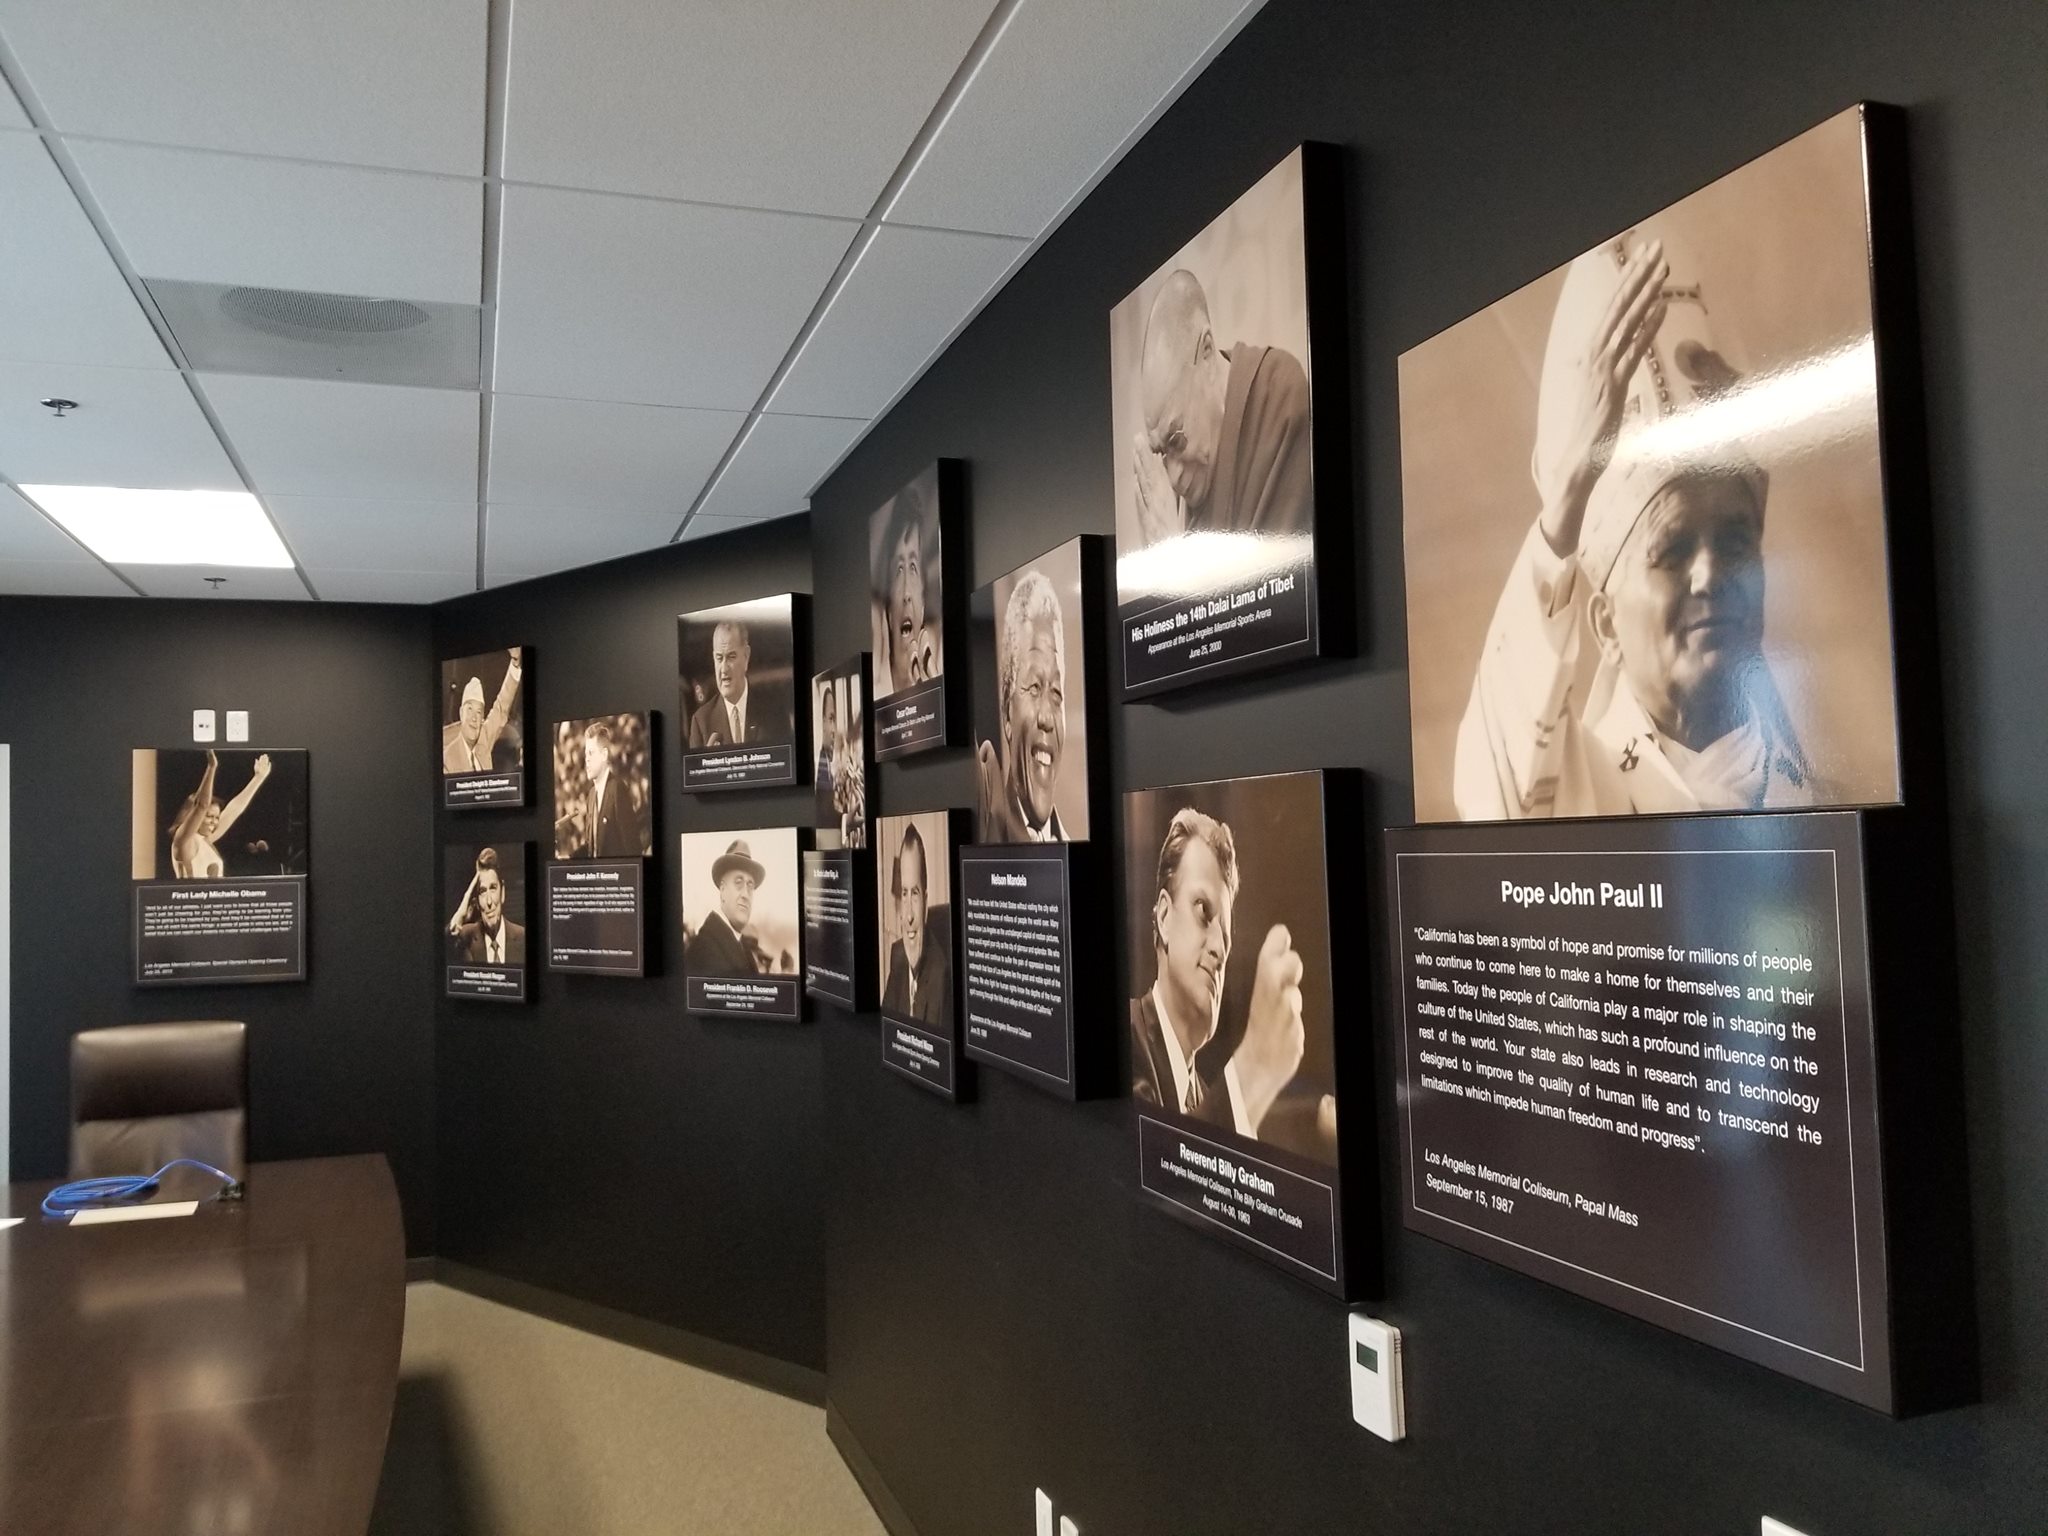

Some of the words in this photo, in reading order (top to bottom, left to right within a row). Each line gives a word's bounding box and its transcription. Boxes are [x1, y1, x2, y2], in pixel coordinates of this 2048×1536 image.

[1132, 627, 1143, 642] His
[1144, 618, 1175, 638] Holiness
[1175, 612, 1188, 628] the
[1189, 604, 1207, 623] 14th
[1208, 595, 1229, 617] Dalai
[1231, 590, 1256, 609] Lama
[1257, 582, 1267, 600] of
[1269, 574, 1294, 596] Tibet
[1185, 632, 1195, 642] Los
[1254, 608, 1272, 621] Arena
[1189, 648, 1201, 659] June
[190, 891, 208, 899] Lady
[209, 890, 239, 898] Michelle
[1501, 881, 1545, 908] Pope
[1549, 882, 1595, 906] John
[1600, 882, 1644, 908] Paul
[1650, 883, 1663, 908] II
[1458, 930, 1475, 945] has
[1476, 931, 1500, 946] been
[1502, 936, 1509, 947] a
[1510, 935, 1546, 952] symbol
[1548, 937, 1559, 952] of
[1562, 938, 1589, 956] hope
[1592, 941, 1613, 956] and
[1617, 944, 1665, 960] promise
[1667, 945, 1685, 962] for
[1689, 947, 1739, 966] millions
[1743, 951, 1757, 967] of
[1762, 954, 1812, 973] people
[1415, 952, 1433, 966] who
[1435, 955, 1473, 970] continue
[1475, 958, 1486, 972] to
[1489, 961, 1516, 975] come
[1519, 961, 1541, 977] here
[1545, 964, 1556, 979] to
[1560, 967, 1590, 983] make
[1594, 972, 1602, 984] a
[1606, 970, 1639, 988] home
[1644, 973, 1662, 990] for
[1666, 976, 1741, 999] themselves
[1747, 985, 1774, 1002] and
[1780, 987, 1814, 1006] their
[1416, 976, 1450, 993] families.
[1452, 980, 1479, 1000] Today
[1481, 984, 1497, 999] the
[1499, 989, 1533, 1005] people
[1535, 991, 1546, 1005] of
[1549, 992, 1600, 1013] California
[1604, 1000, 1628, 1020] play
[1632, 1006, 1640, 1018] a
[1644, 1006, 1679, 1025] major
[1683, 1010, 1708, 1027] role
[1713, 1012, 1725, 1029] in
[1730, 1015, 1786, 1040] shaping
[1791, 1021, 1816, 1041] the
[1417, 1001, 1446, 1017] culture
[1447, 1005, 1456, 1019] of
[1458, 1006, 1473, 1021] the
[1475, 1008, 1505, 1027] United
[1507, 1013, 1542, 1034] States,
[1544, 1020, 1575, 1037] which
[1578, 1024, 1598, 1041] has
[1601, 1030, 1629, 1046] such
[1632, 1036, 1641, 1048] a
[1643, 1036, 1700, 1057] profound
[1704, 1042, 1765, 1067] influence
[1770, 1056, 1789, 1071] on
[1793, 1056, 1818, 1076] the
[1419, 1027, 1435, 1040] rest
[1438, 1029, 1447, 1042] of
[1451, 1031, 1466, 1046] the
[1470, 1036, 1498, 1052] world.
[1503, 1039, 1525, 1056] Your
[1531, 1046, 1556, 1062] state
[1562, 1051, 1584, 1067] also
[1590, 1054, 1620, 1074] leads
[1627, 1061, 1637, 1078] in
[1644, 1067, 1697, 1088] research
[1705, 1078, 1731, 1094] and
[1739, 1081, 1820, 1114] technology
[1420, 1050, 1458, 1070] designed
[1462, 1058, 1472, 1072] to
[1476, 1060, 1513, 1081] improve
[1518, 1069, 1534, 1086] the
[1539, 1076, 1573, 1097] quality
[1579, 1082, 1590, 1097] of
[1596, 1084, 1635, 1107] human
[1641, 1093, 1659, 1112] life
[1666, 1102, 1690, 1118] and
[1697, 1105, 1711, 1122] to
[1718, 1109, 1789, 1138] transcend
[1797, 1124, 1822, 1145] the
[1421, 1074, 1463, 1096] limitations
[1464, 1085, 1492, 1102] which
[1493, 1090, 1529, 1111] impede
[1531, 1098, 1566, 1120] human
[1568, 1107, 1613, 1131] freedom
[1616, 1121, 1638, 1137] and
[1180, 1143, 1217, 1173] Reverend
[1218, 1158, 1237, 1182] Billy
[1238, 1167, 1275, 1197] Graham
[1425, 1148, 1440, 1165] Los
[1441, 1154, 1476, 1176] Angeles
[1478, 1164, 1521, 1190] Memorial
[1522, 1178, 1571, 1208] Coliseum,
[1575, 1193, 1606, 1216] Papal
[1608, 1203, 1639, 1227] Mass
[1426, 1173, 1473, 1200] September
[1475, 1189, 1488, 1208] 15,
[1491, 1195, 1514, 1214] 1987
[1244, 1193, 1255, 1209] Billy
[1255, 1198, 1277, 1217] Graham
[1278, 1208, 1303, 1229] Crusade
